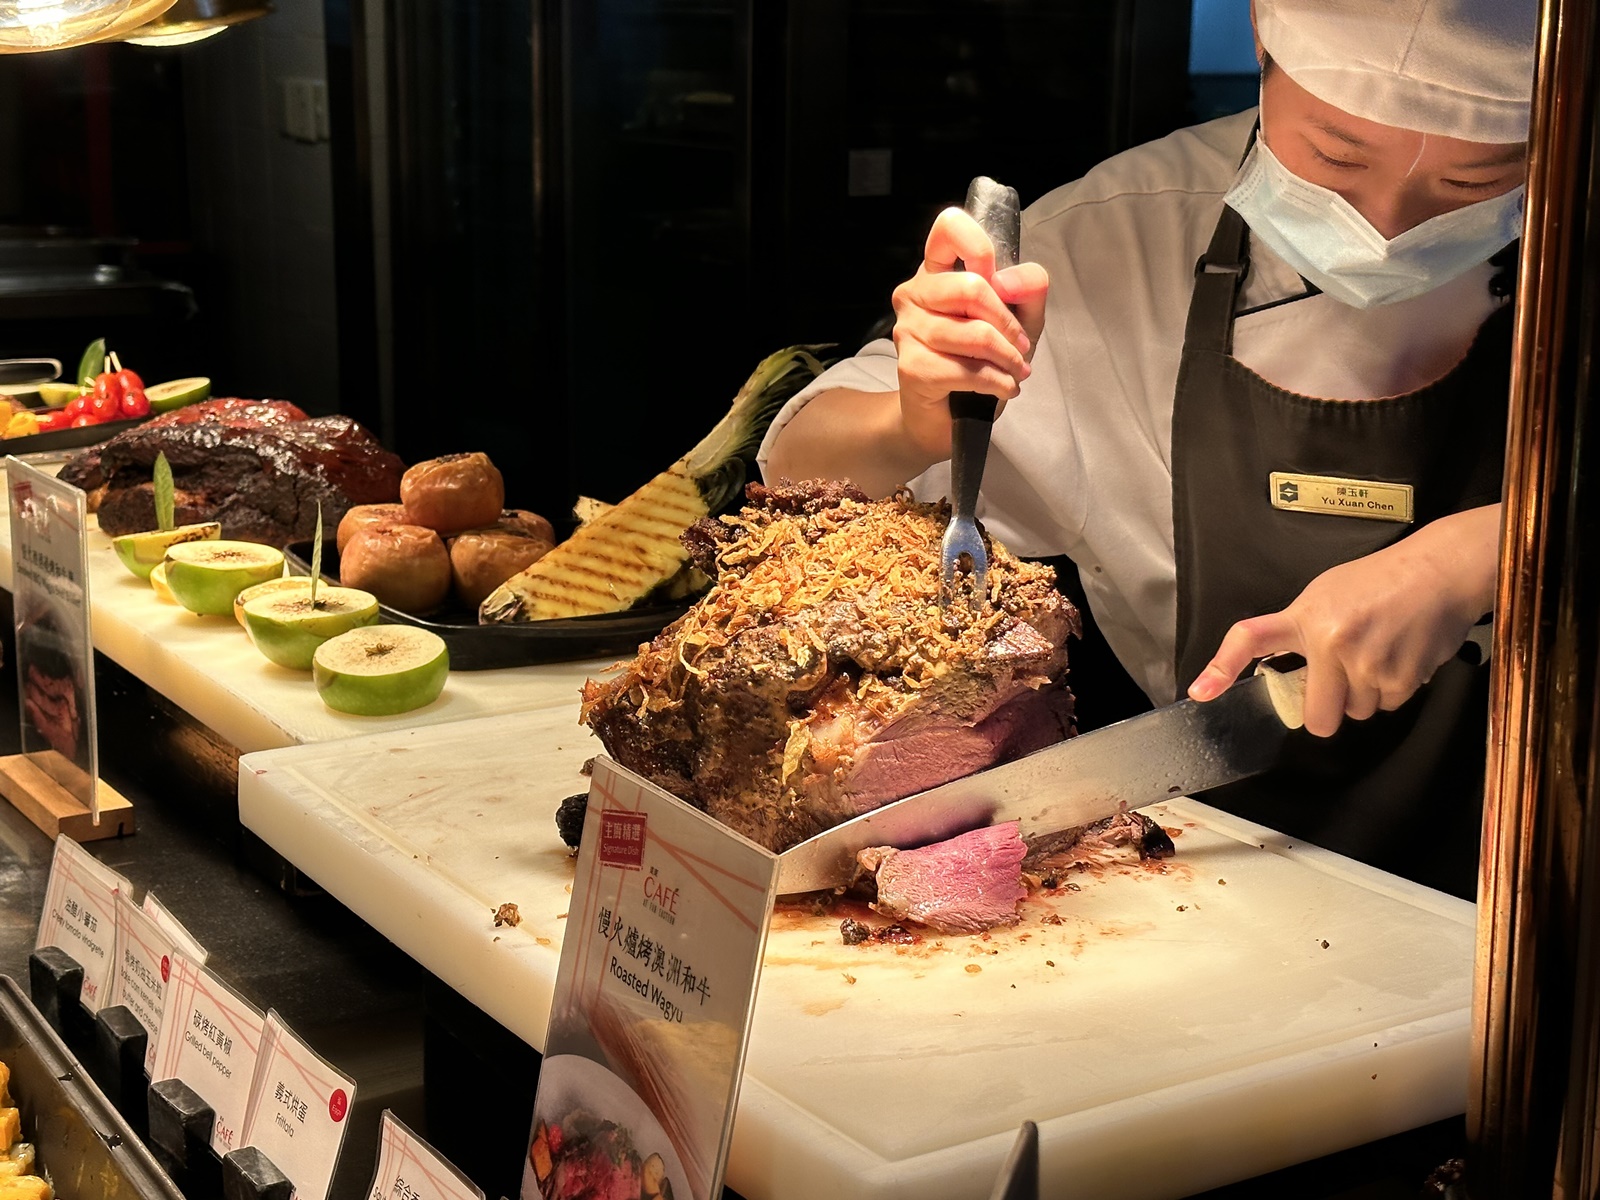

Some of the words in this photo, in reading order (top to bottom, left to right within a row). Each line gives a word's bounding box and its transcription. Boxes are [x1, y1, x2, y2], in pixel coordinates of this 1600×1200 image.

[1321, 496, 1336, 506] Yu
[1338, 499, 1364, 508] Xuan
[1367, 500, 1394, 511] Chen
[1336, 486, 1369, 499] 陳玉軒
[602, 843, 627, 856] Signature
[627, 847, 640, 857] Dish
[603, 821, 642, 842] 主廚精選
[643, 876, 680, 915] CAFÉ
[65, 920, 81, 940] tomato
[82, 933, 105, 959] vinaigrette
[597, 906, 711, 1006] 慢火爐烤澳洲和牛
[609, 955, 649, 998] Roasted
[651, 984, 683, 1024] Wagyu
[184, 1030, 203, 1053] Grilled
[202, 1043, 213, 1061] bell
[212, 1055, 233, 1080] pepper
[274, 1081, 308, 1124] 義式烘蛋
[216, 1120, 234, 1146] CAFÉ
